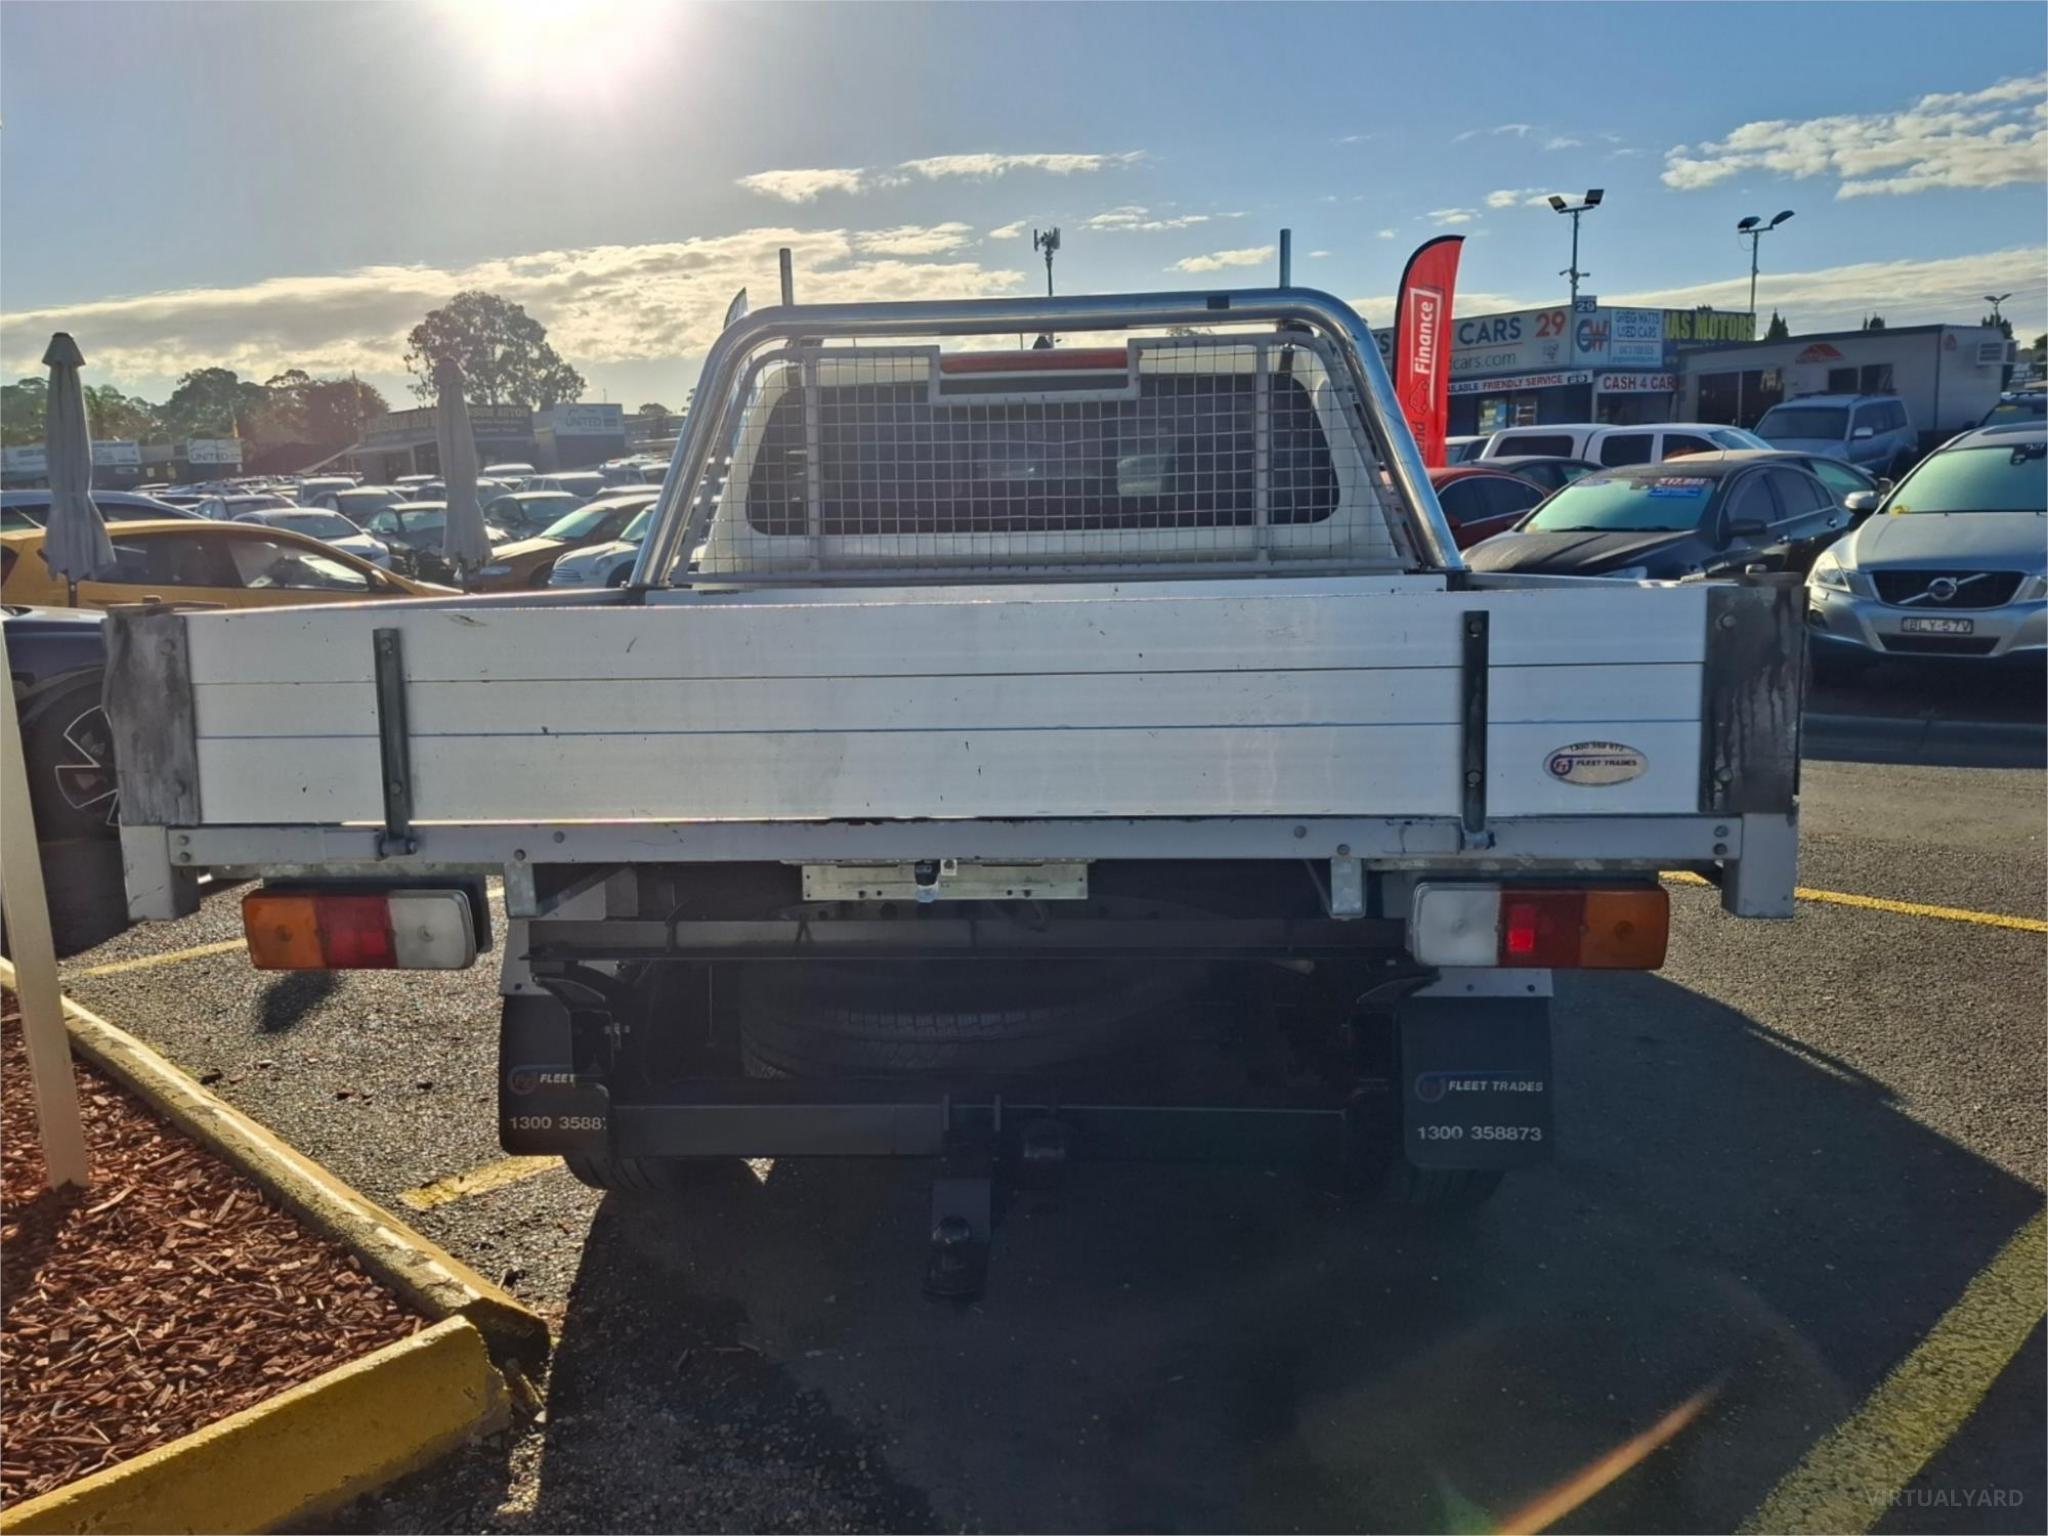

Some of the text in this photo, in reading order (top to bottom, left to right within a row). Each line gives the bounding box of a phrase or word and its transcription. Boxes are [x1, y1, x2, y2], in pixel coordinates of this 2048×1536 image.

[1577, 302, 1595, 312] 29
[1458, 317, 1522, 345] CARS
[1535, 310, 1567, 338] 29
[1695, 313, 1756, 342] MOTORS
[1414, 301, 1434, 375] Finance
[1450, 352, 1517, 370] cars.com
[1482, 379, 1523, 390] FRIENDLY
[1526, 375, 1562, 386] SERVICE
[1603, 376, 1636, 390] CASH
[1640, 376, 1647, 389] 4
[540, 1073, 576, 1084] FLEET
[1448, 1080, 1544, 1092] FLEET TRADES
[510, 1116, 552, 1130] 1300
[1417, 1125, 1542, 1141] 1300 358873
